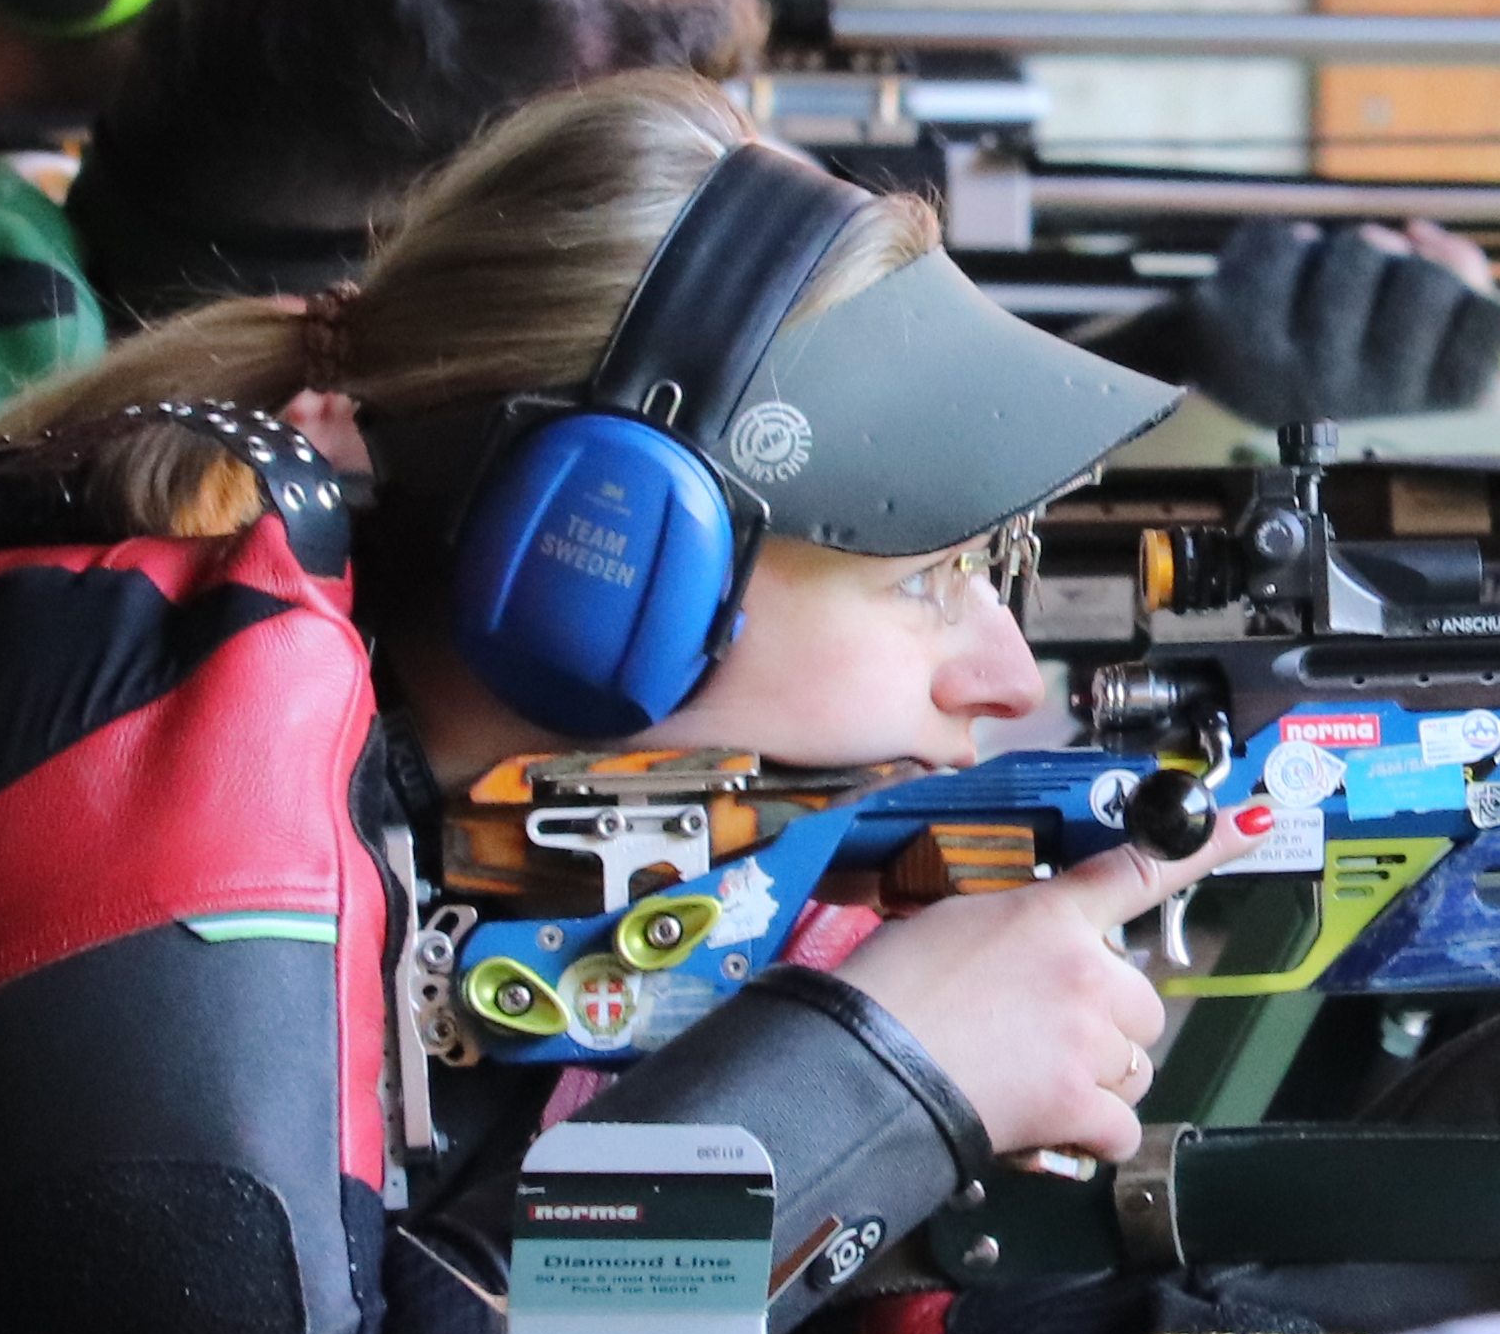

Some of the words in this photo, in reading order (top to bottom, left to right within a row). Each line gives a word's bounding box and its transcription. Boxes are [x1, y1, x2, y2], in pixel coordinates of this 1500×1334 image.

[568, 515, 627, 555] TEAM
[540, 532, 635, 589] SWEDEN
[1286, 723, 1374, 741] norma
[1294, 818, 1321, 829] Final
[1260, 849, 1282, 860] SUI
[1285, 849, 1312, 860] 2024
[534, 1204, 639, 1220] norma
[544, 1254, 663, 1268] Diamond
[676, 1254, 731, 1268] Line
